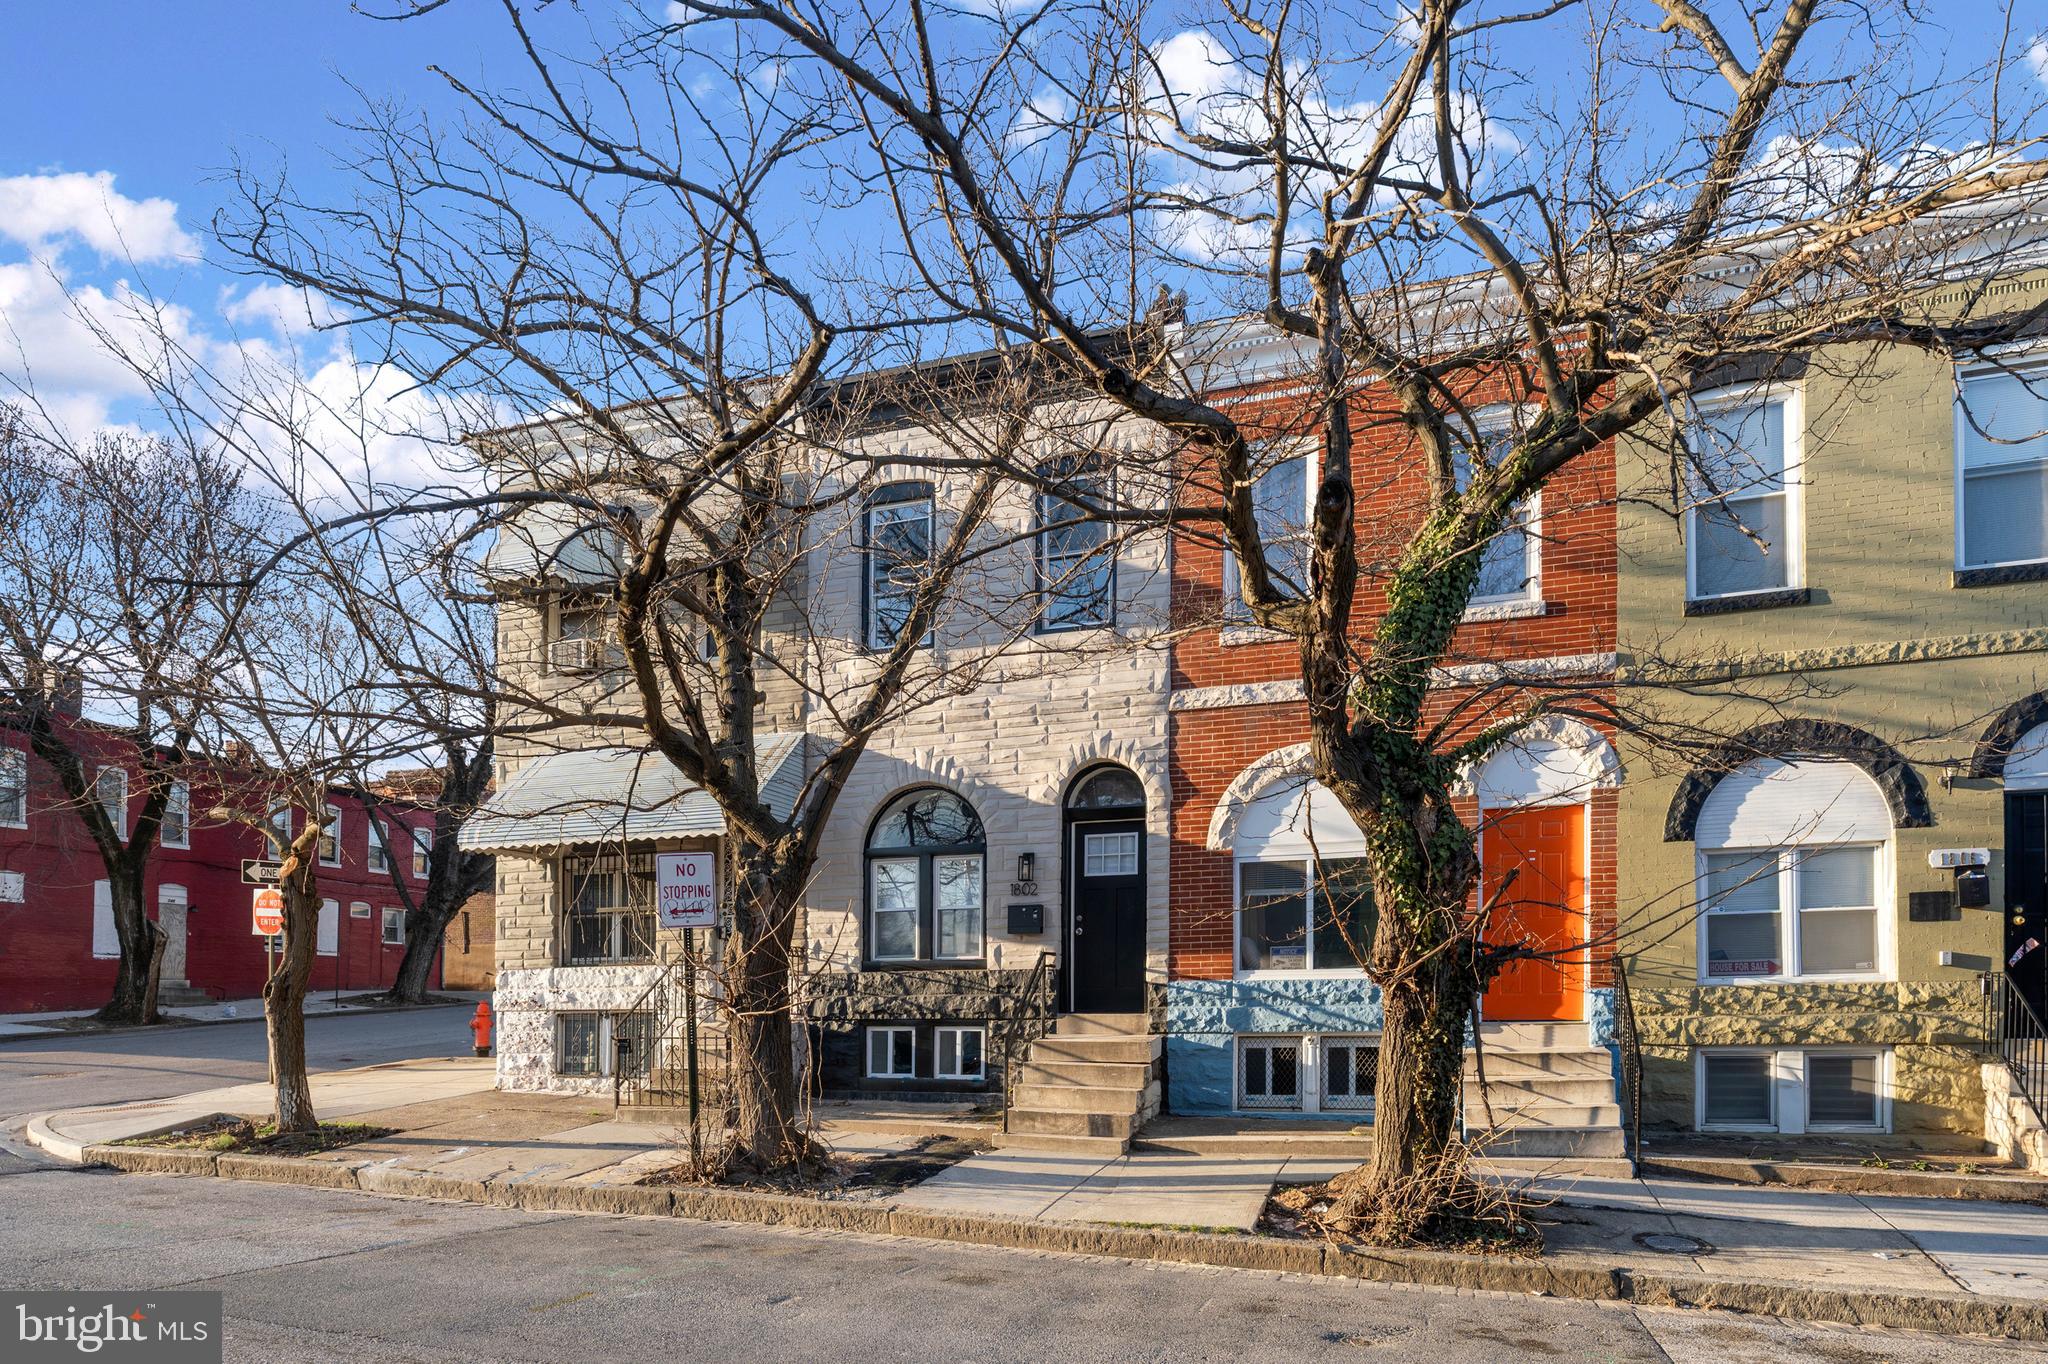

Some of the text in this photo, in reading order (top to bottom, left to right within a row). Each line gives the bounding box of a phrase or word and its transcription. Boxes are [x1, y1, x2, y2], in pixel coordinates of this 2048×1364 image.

[260, 867, 278, 878] ONE
[676, 863, 696, 877] NO
[663, 884, 711, 899] STOPPING
[1011, 882, 1038, 896] 1802
[260, 918, 279, 926] ENTER
[1710, 961, 1769, 972] HOUSE FOR SALE
